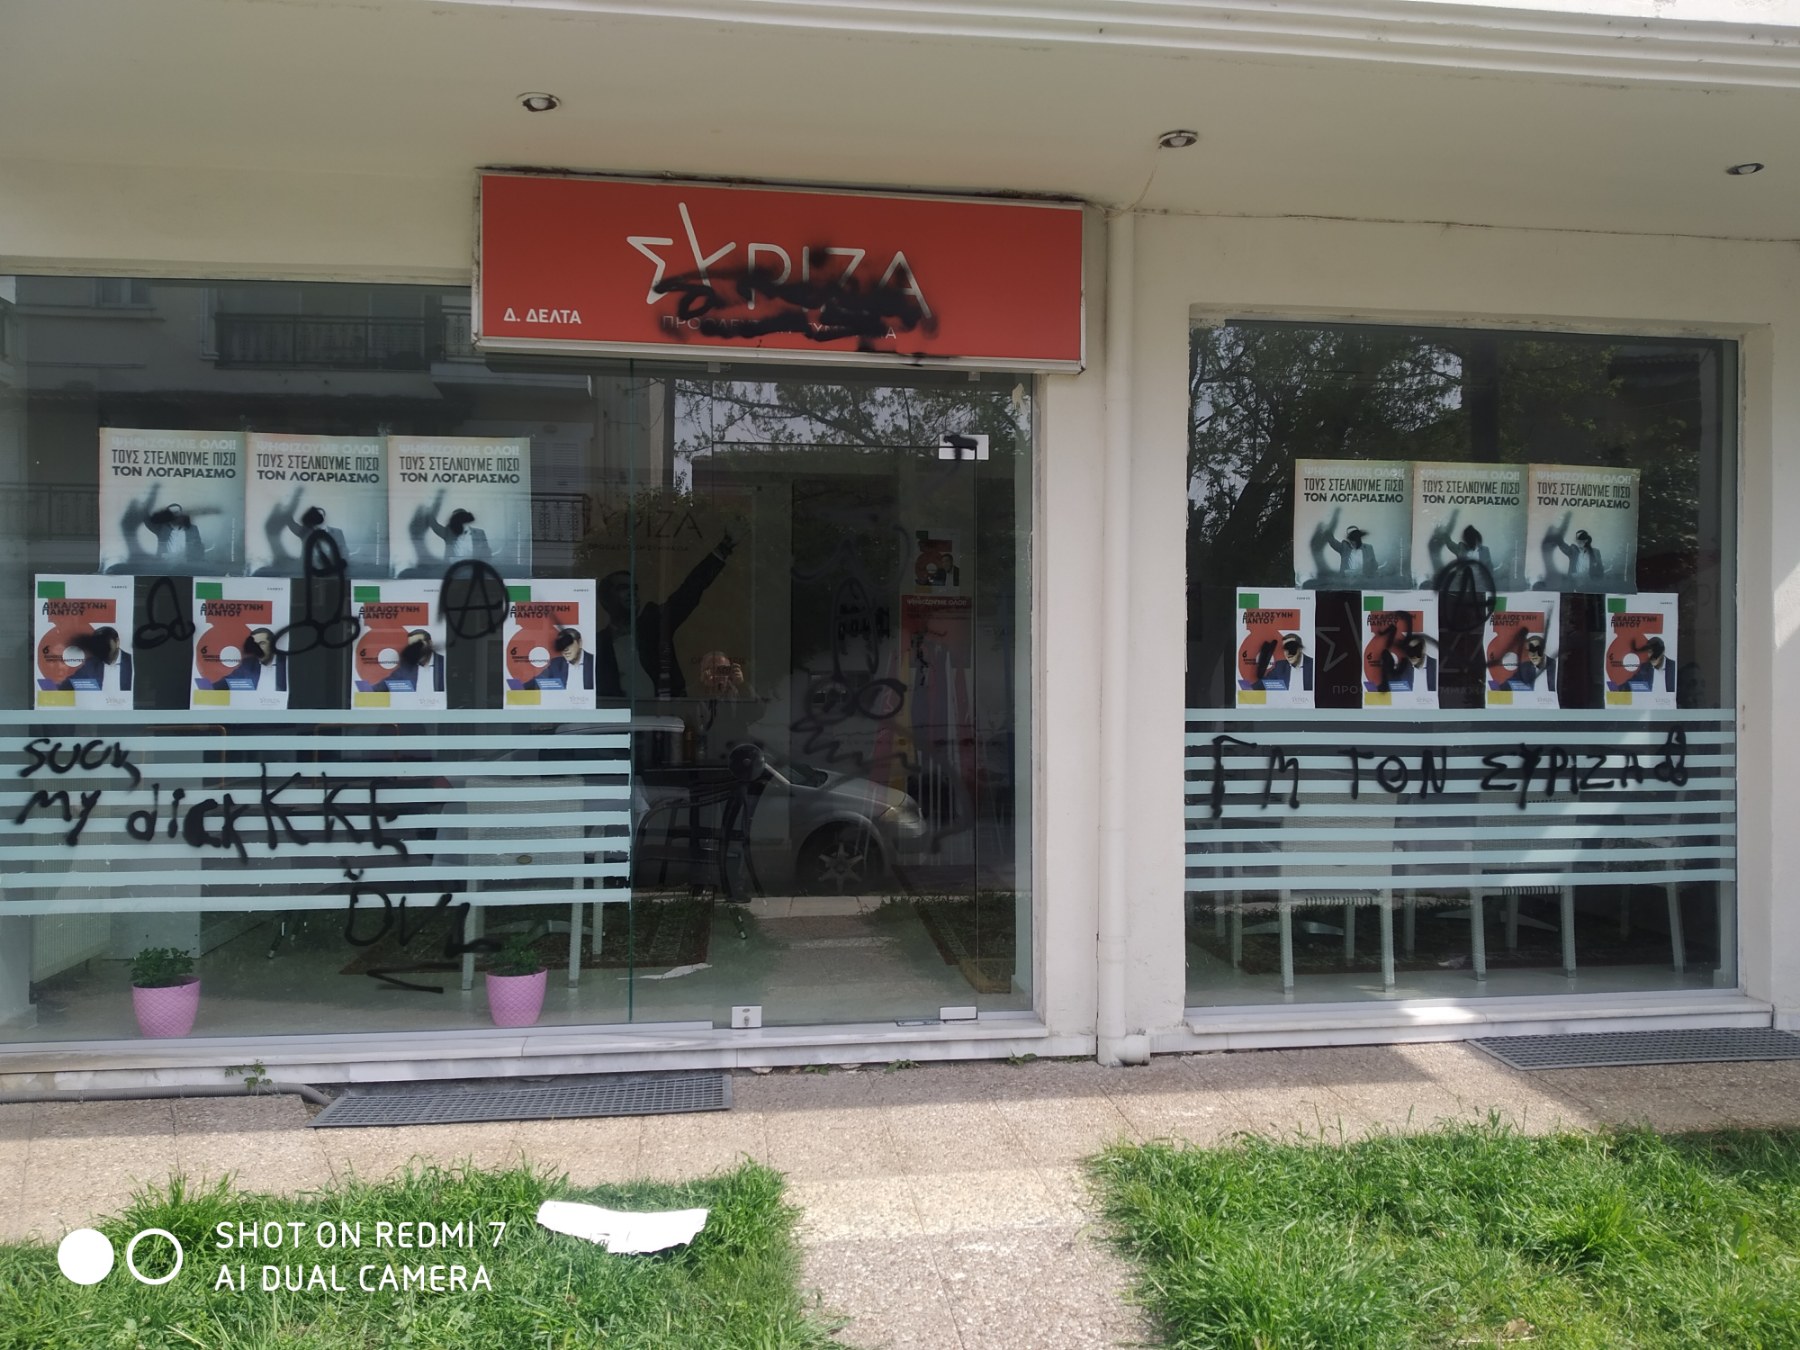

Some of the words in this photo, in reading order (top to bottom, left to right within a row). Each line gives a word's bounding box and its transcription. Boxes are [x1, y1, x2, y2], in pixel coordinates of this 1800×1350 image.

[503, 307, 521, 322] Δ.
[526, 308, 582, 324] ΔΕΛΤΑ
[112, 449, 139, 464] ΤΟΥΣ
[144, 450, 208, 465] ΣΤΕΛΝΟΥΜΕ
[213, 452, 236, 466] ΠΙΣΩ
[257, 454, 284, 468] ΤΟΥΣ
[288, 455, 351, 470] ΣΤΕΛΝΟΥΜΕ
[356, 457, 379, 471] ΠΙΣΩ
[400, 456, 424, 470] ΤΟΥΣ
[429, 457, 492, 471] ΣΤΕΛΝΟΥΜΕ
[497, 458, 520, 471] ΠΙΣΩ
[112, 466, 142, 476] ΤΟΝ
[146, 467, 236, 478] ΛΟΓΑΡΙΑΣΜΟ
[257, 470, 286, 480] ΤΟΝ
[290, 472, 380, 483] ΛΟΓΑΡΙΑΣΜΟ
[400, 473, 428, 482] ΤΟΝ
[432, 473, 520, 483] ΛΟΓΑΡΙΑΣΜΟ
[1304, 478, 1326, 491] ΤΟΥΣ
[1328, 479, 1381, 492] ΣΤΕΛΝΟΥΜΕ
[1384, 480, 1404, 492] ΠΙΣΩ
[1423, 480, 1443, 492] ΤΟΥΣ
[1446, 480, 1498, 494] ΣΤΕΛΝΟΥΜΕ
[1500, 482, 1520, 494] ΠΙΣΩ
[1537, 482, 1558, 494] ΤΟΥΣ
[1560, 483, 1610, 497] ΣΤΕΛΝΟΥΜΕ
[1613, 486, 1630, 498] ΠΙΣΩ
[1304, 493, 1327, 502] ΤΟΝ
[1330, 494, 1404, 503] ΛΟΓΑΡΙΑΣΜΟ
[1423, 495, 1445, 504] ΤΟΝ
[1448, 496, 1520, 506] ΛΟΓΑΡΙΑΣΜΟ
[1537, 496, 1558, 506] ΤΟΝ
[1561, 498, 1630, 509] ΛΟΓΑΡΙΑΣΜΟ
[42, 602, 107, 610] ΔΙΚΑΙΟΣΥΝΗ
[42, 608, 85, 616] ΠΑΝΤΟΥ
[201, 603, 264, 611] ΔΙΚΑΙΟΣΥΝΗ
[358, 612, 398, 620] ΠΑΝΤΟΥ
